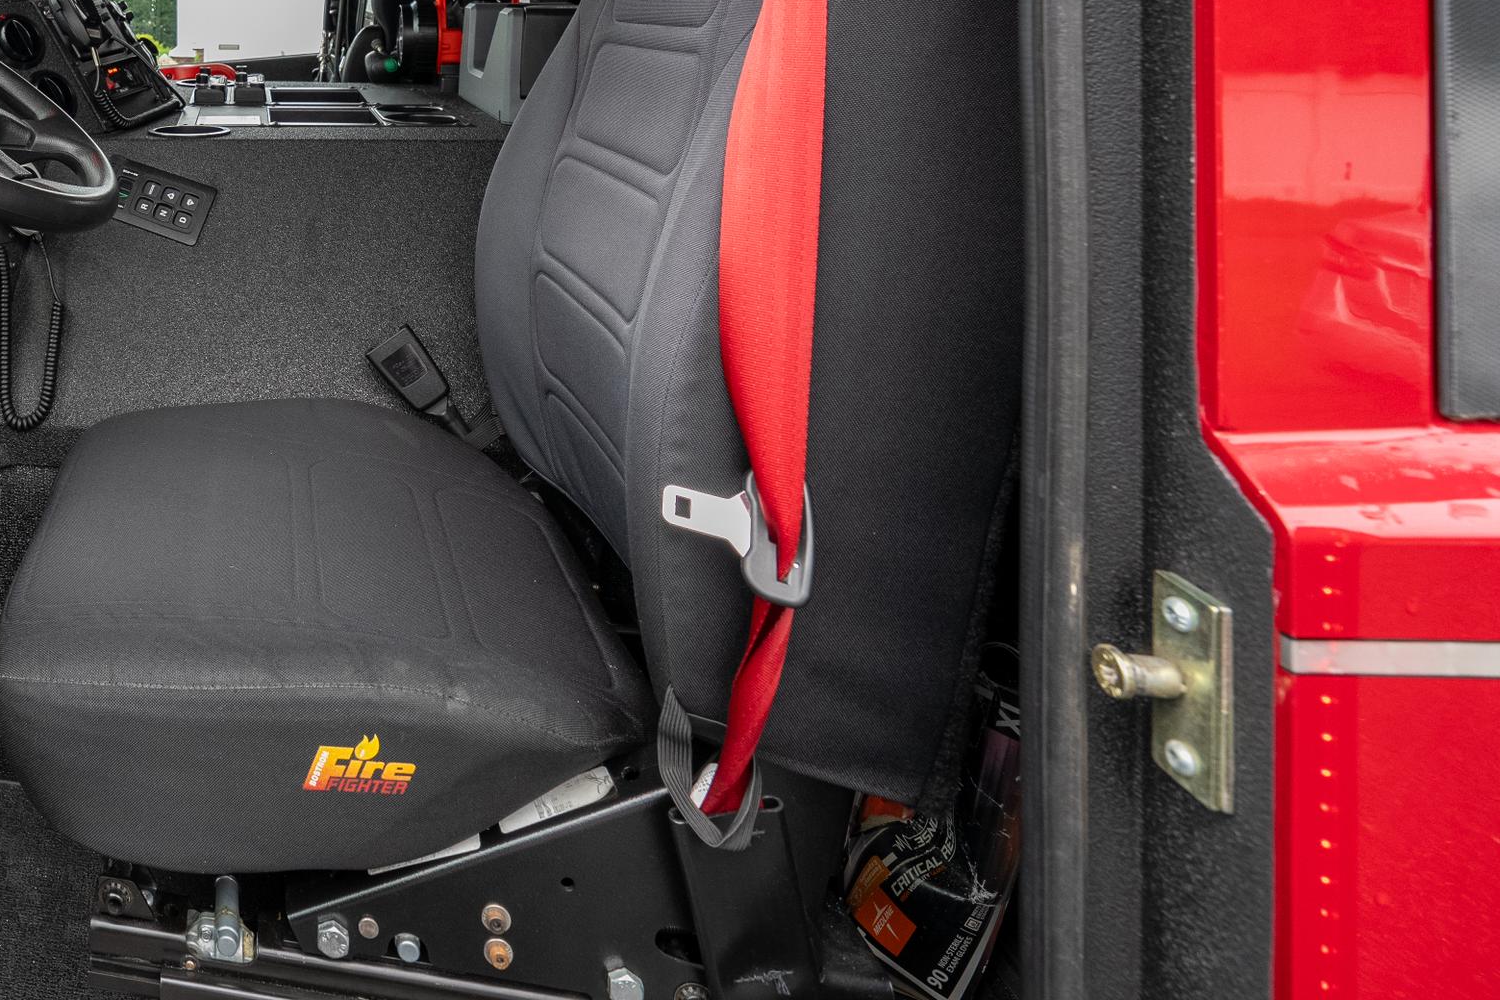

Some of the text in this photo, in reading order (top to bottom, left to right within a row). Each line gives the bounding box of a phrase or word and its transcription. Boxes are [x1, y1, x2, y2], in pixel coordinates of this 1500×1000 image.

[140, 203, 149, 211] R
[159, 209, 168, 217] N
[179, 216, 187, 225] D
[303, 734, 417, 791] Fire
[327, 778, 408, 795] FIGHTER
[891, 856, 943, 897] CRITICAL
[873, 904, 894, 936] MEDLINE
[937, 934, 964, 968] NON-STERILE
[946, 936, 973, 973] EXAM GLOVES
[927, 968, 949, 991] 90
